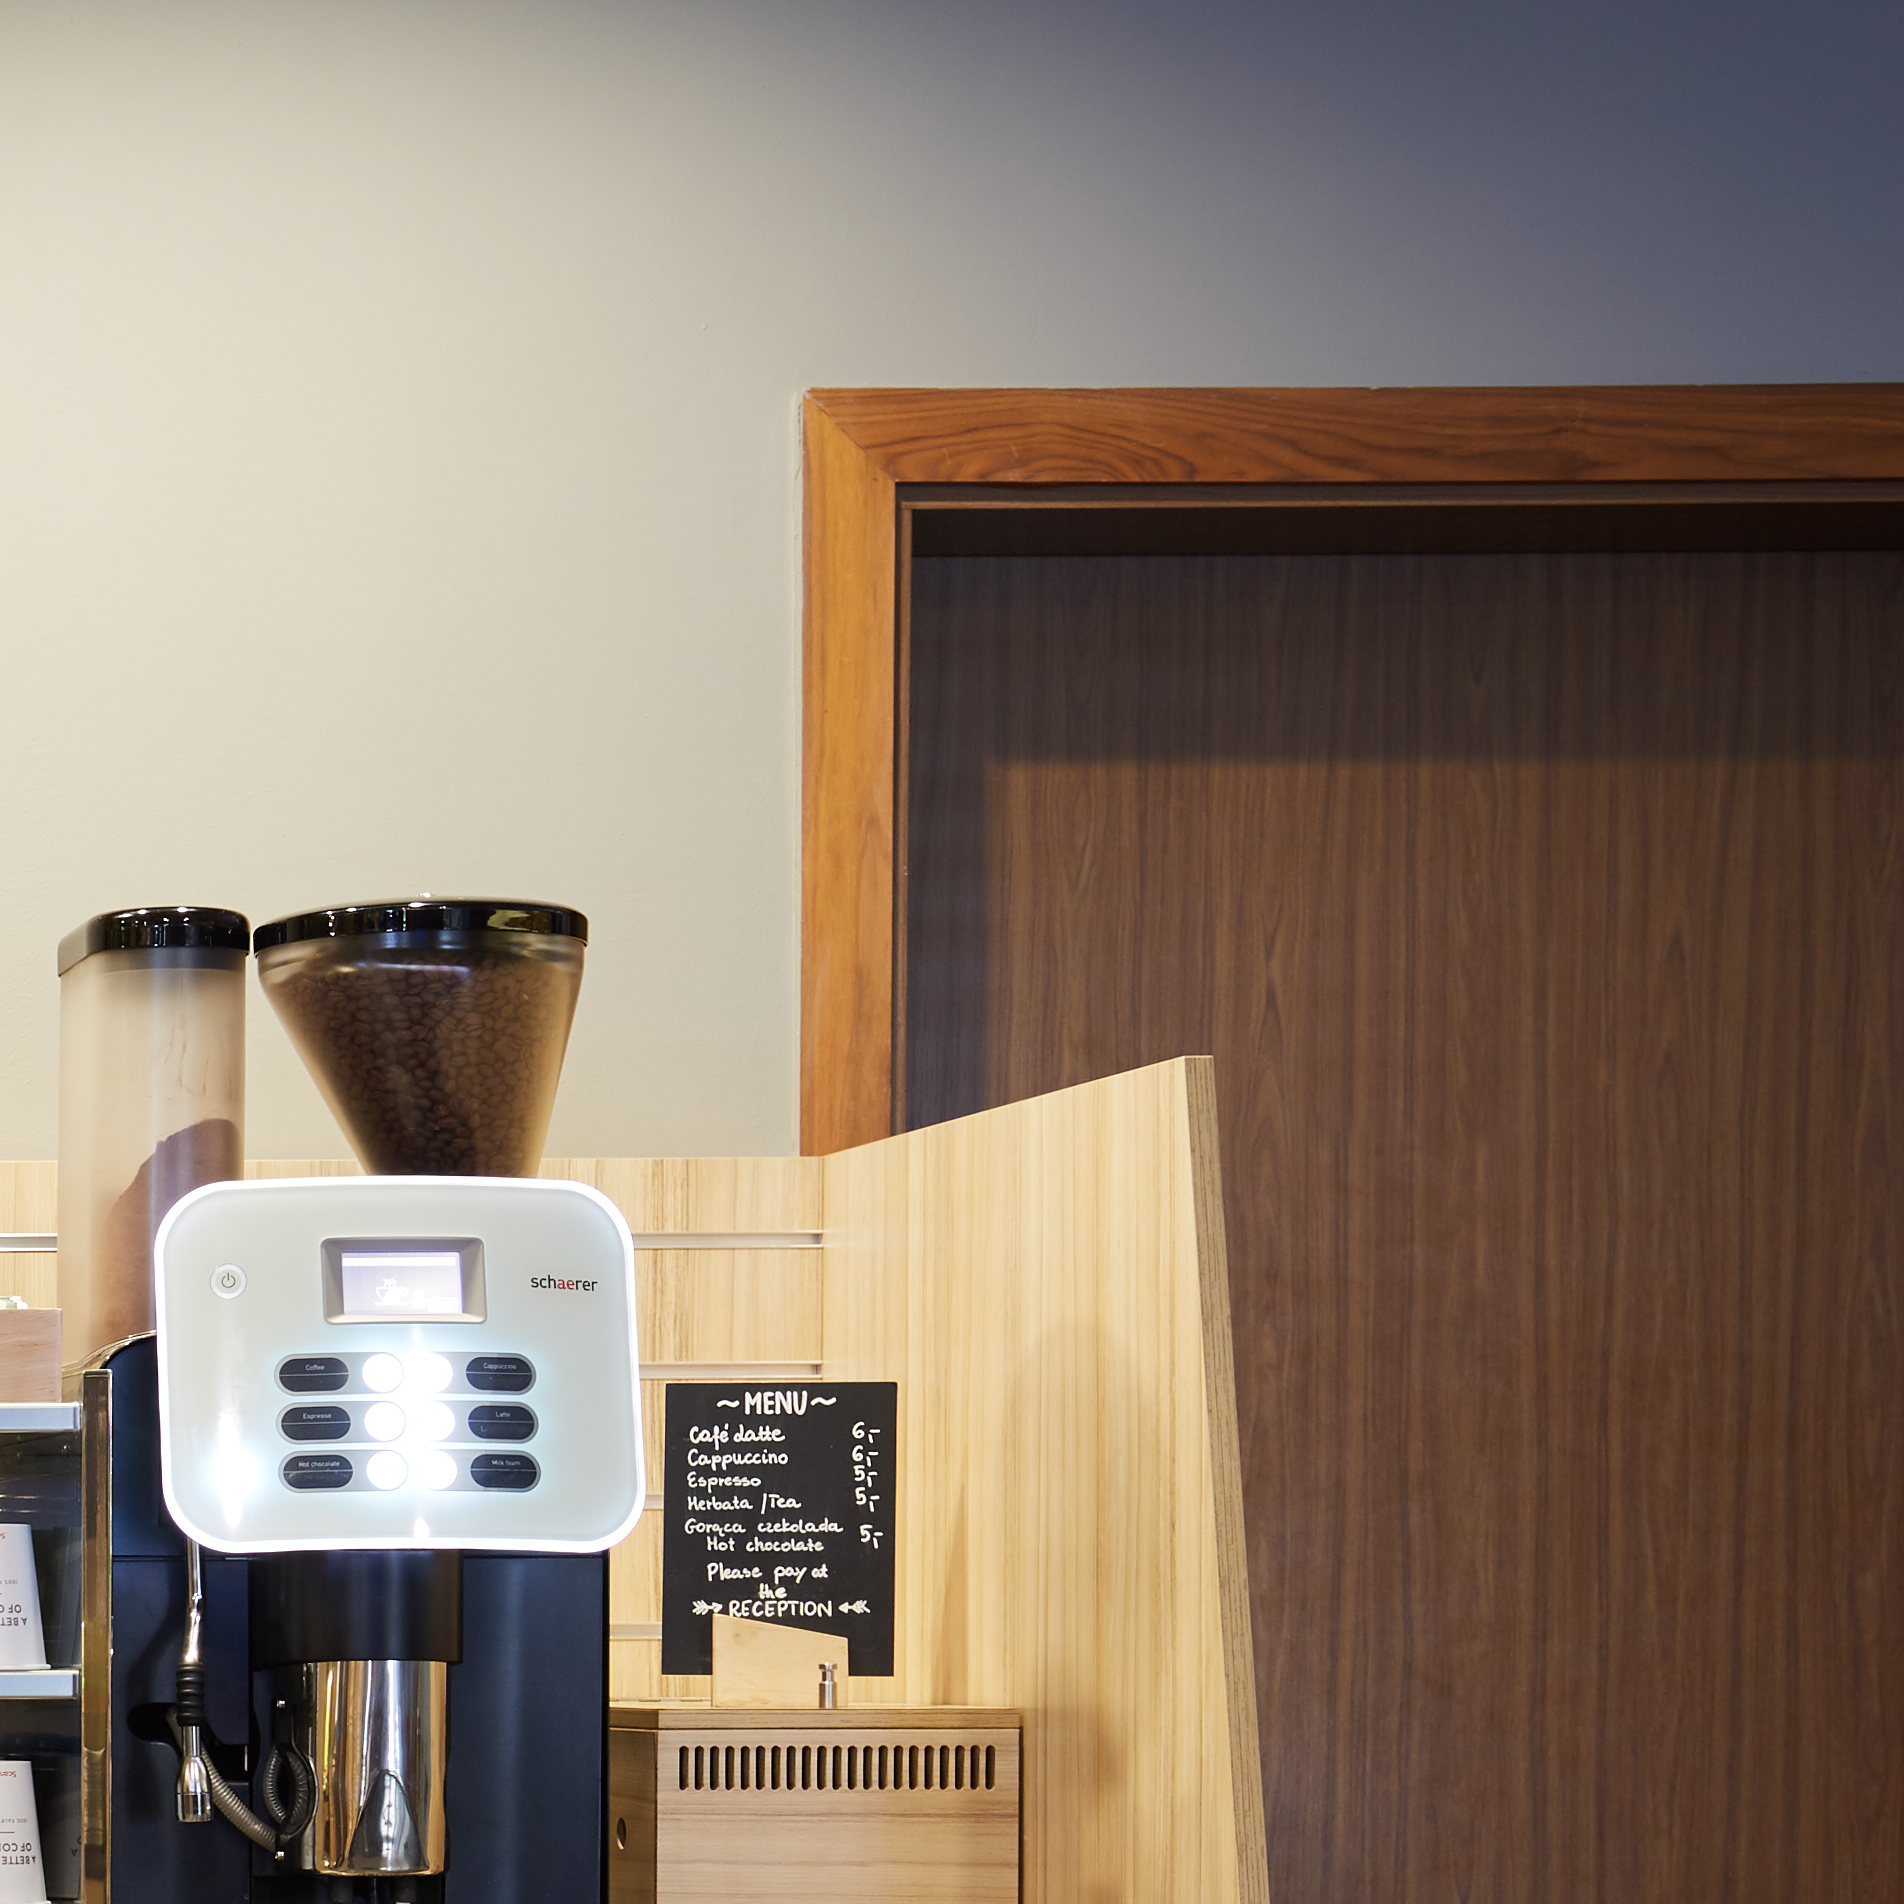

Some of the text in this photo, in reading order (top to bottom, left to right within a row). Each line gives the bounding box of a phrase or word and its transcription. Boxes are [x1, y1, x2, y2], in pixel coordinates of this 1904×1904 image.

[530, 1274, 598, 1292] schaerer
[305, 1363, 325, 1372] Coffee
[744, 1390, 808, 1416] MENU
[302, 1412, 332, 1421] Espresso
[688, 1423, 730, 1451] Café
[687, 1448, 789, 1471] Cappuccino
[686, 1471, 762, 1494] Espresso
[687, 1495, 754, 1511] Herbata
[684, 1518, 747, 1537] Gorąca
[757, 1517, 844, 1534] czekolada
[706, 1536, 825, 1552] Hot chocolate
[706, 1561, 829, 1584] Please pay at
[758, 1582, 787, 1599] the
[6, 1604, 22, 1615] OF
[728, 1599, 833, 1618] RECEPTION
[20, 1616, 28, 1627] A
